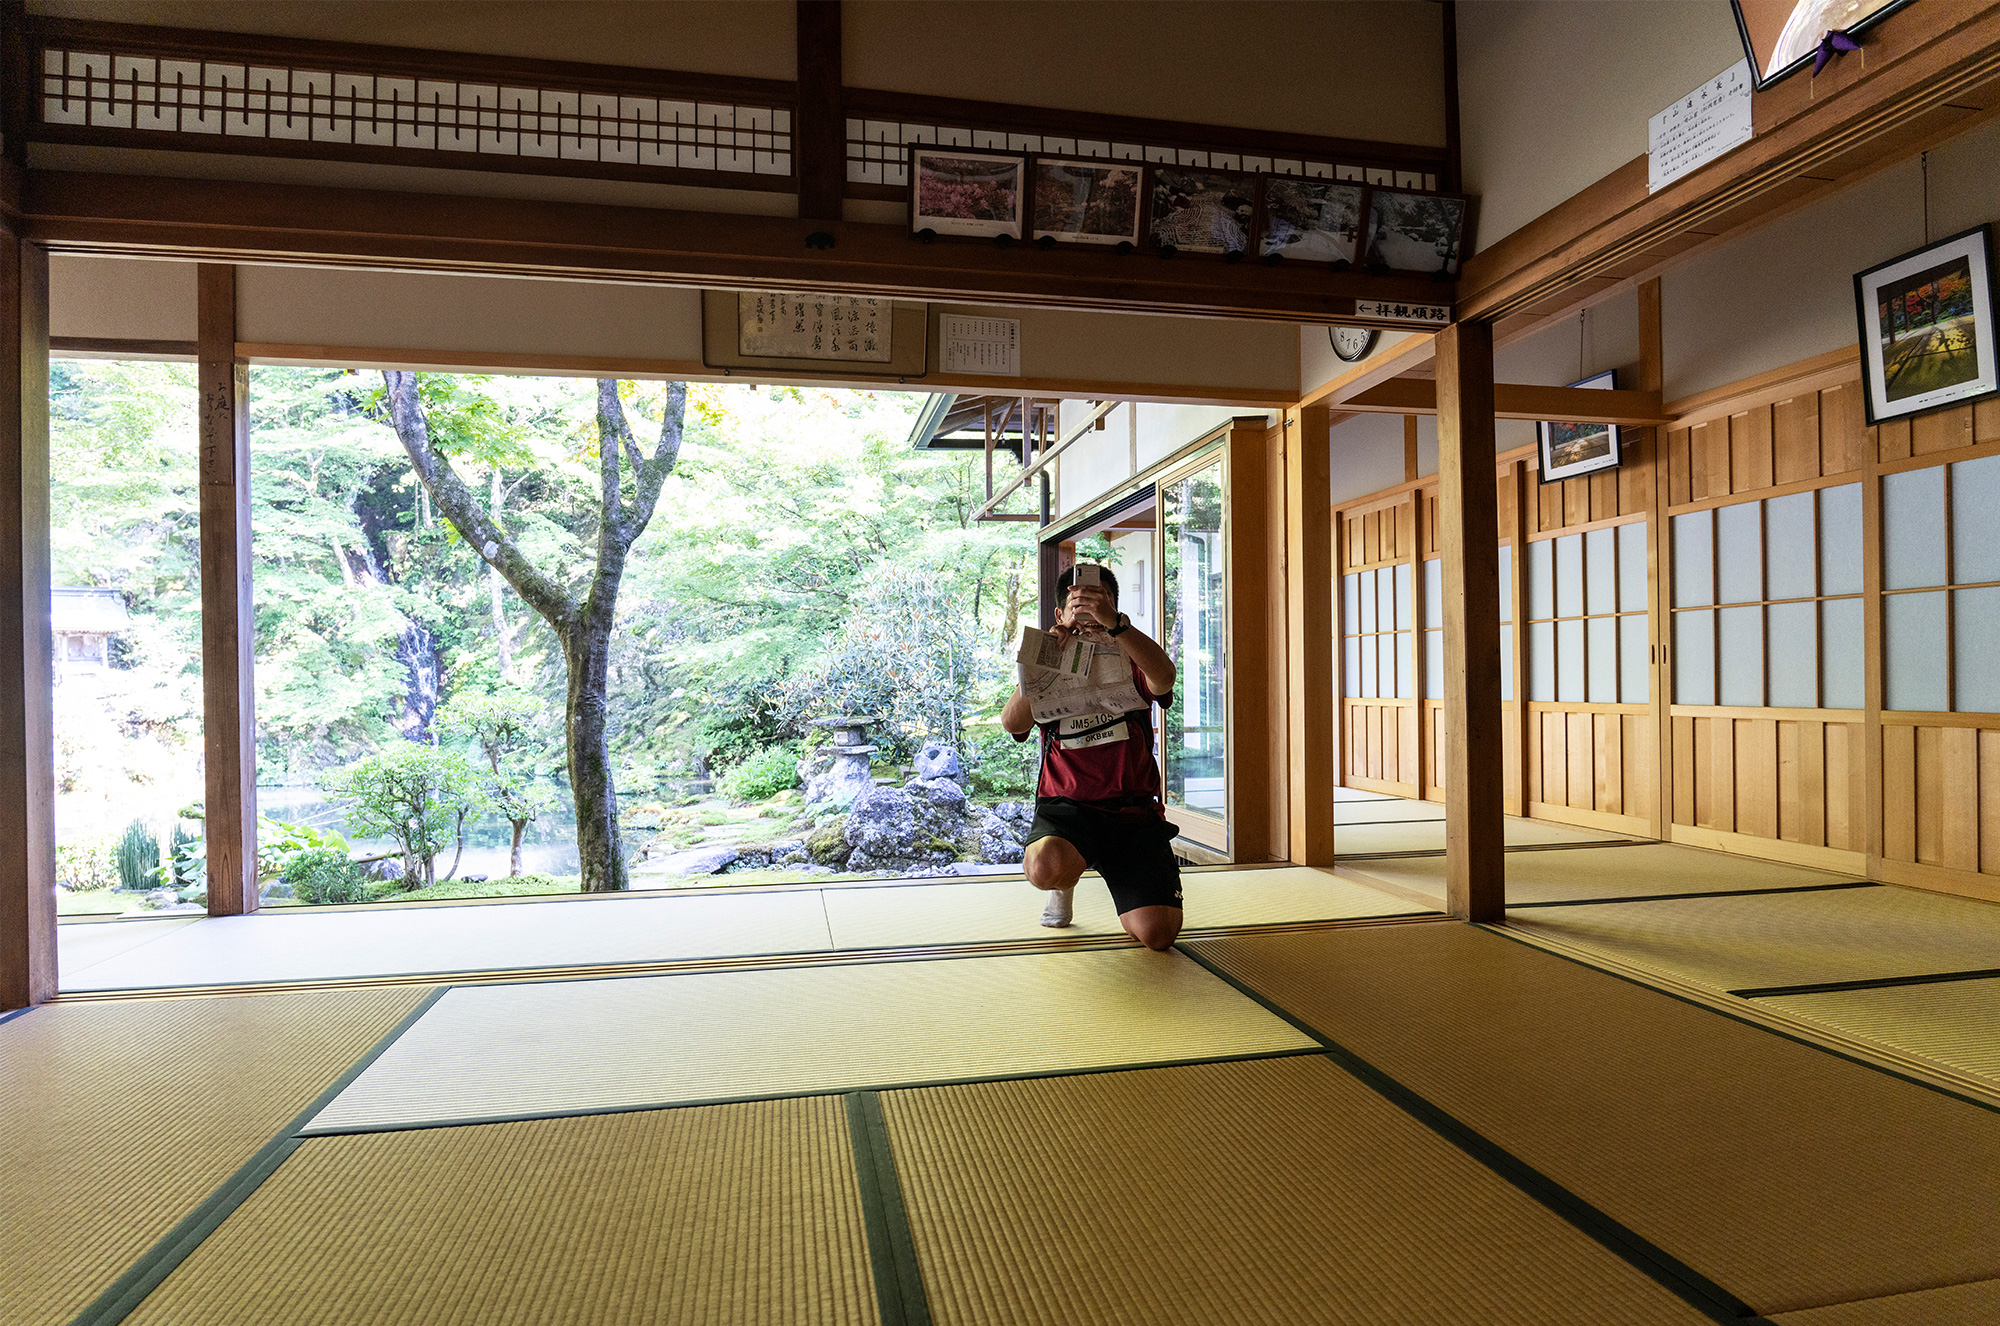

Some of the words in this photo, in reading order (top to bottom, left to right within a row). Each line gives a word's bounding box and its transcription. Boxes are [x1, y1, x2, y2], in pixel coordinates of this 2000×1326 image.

[1375, 303, 1447, 321] 拝観順路
[1339, 331, 1345, 343] 8
[1360, 331, 1366, 343] 5
[1346, 338, 1351, 350] 7
[1352, 338, 1358, 350] 6
[1070, 713, 1114, 729] JM5-105
